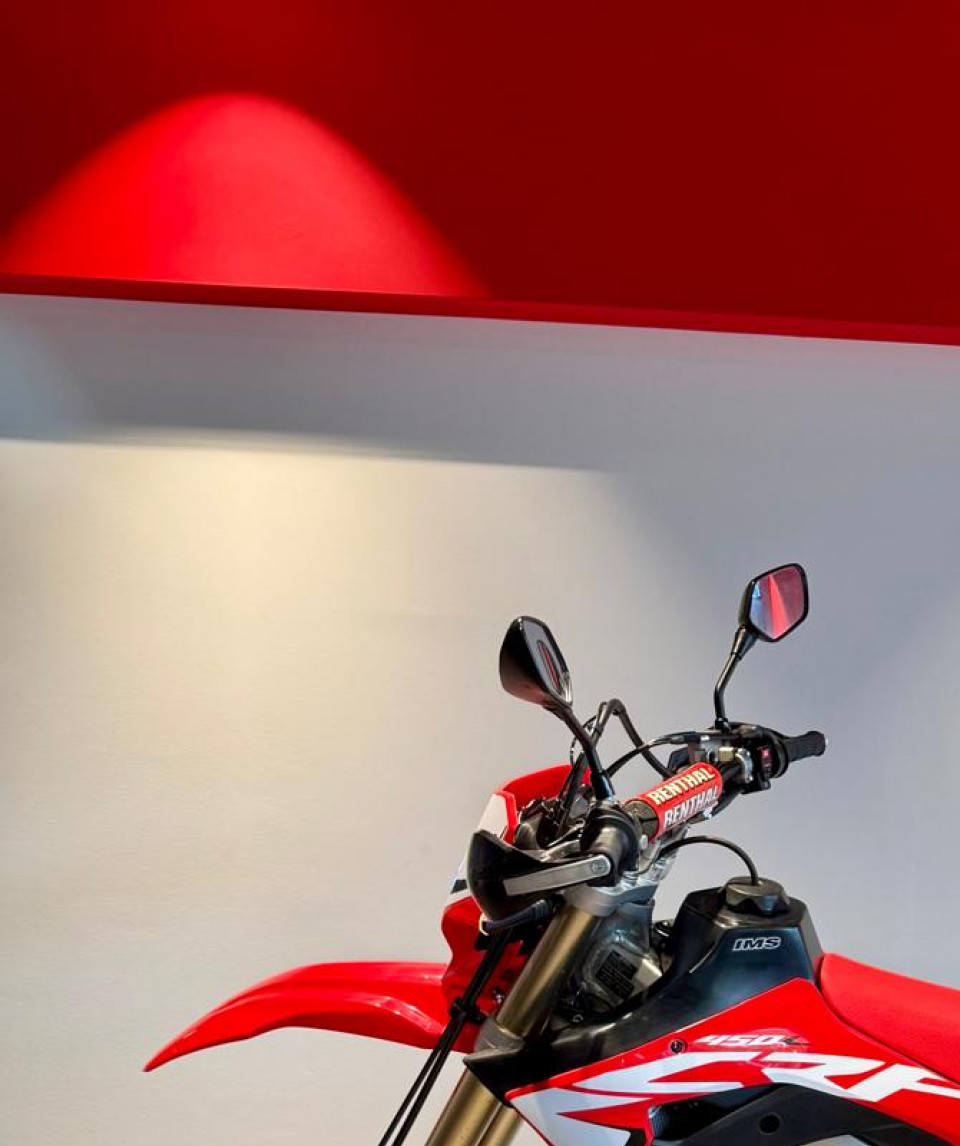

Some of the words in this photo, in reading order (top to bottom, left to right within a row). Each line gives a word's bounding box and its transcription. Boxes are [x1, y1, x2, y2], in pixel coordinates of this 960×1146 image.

[645, 767, 716, 805] RENTHAL
[664, 785, 719, 827] RENTHAL
[732, 936, 782, 950] IMS
